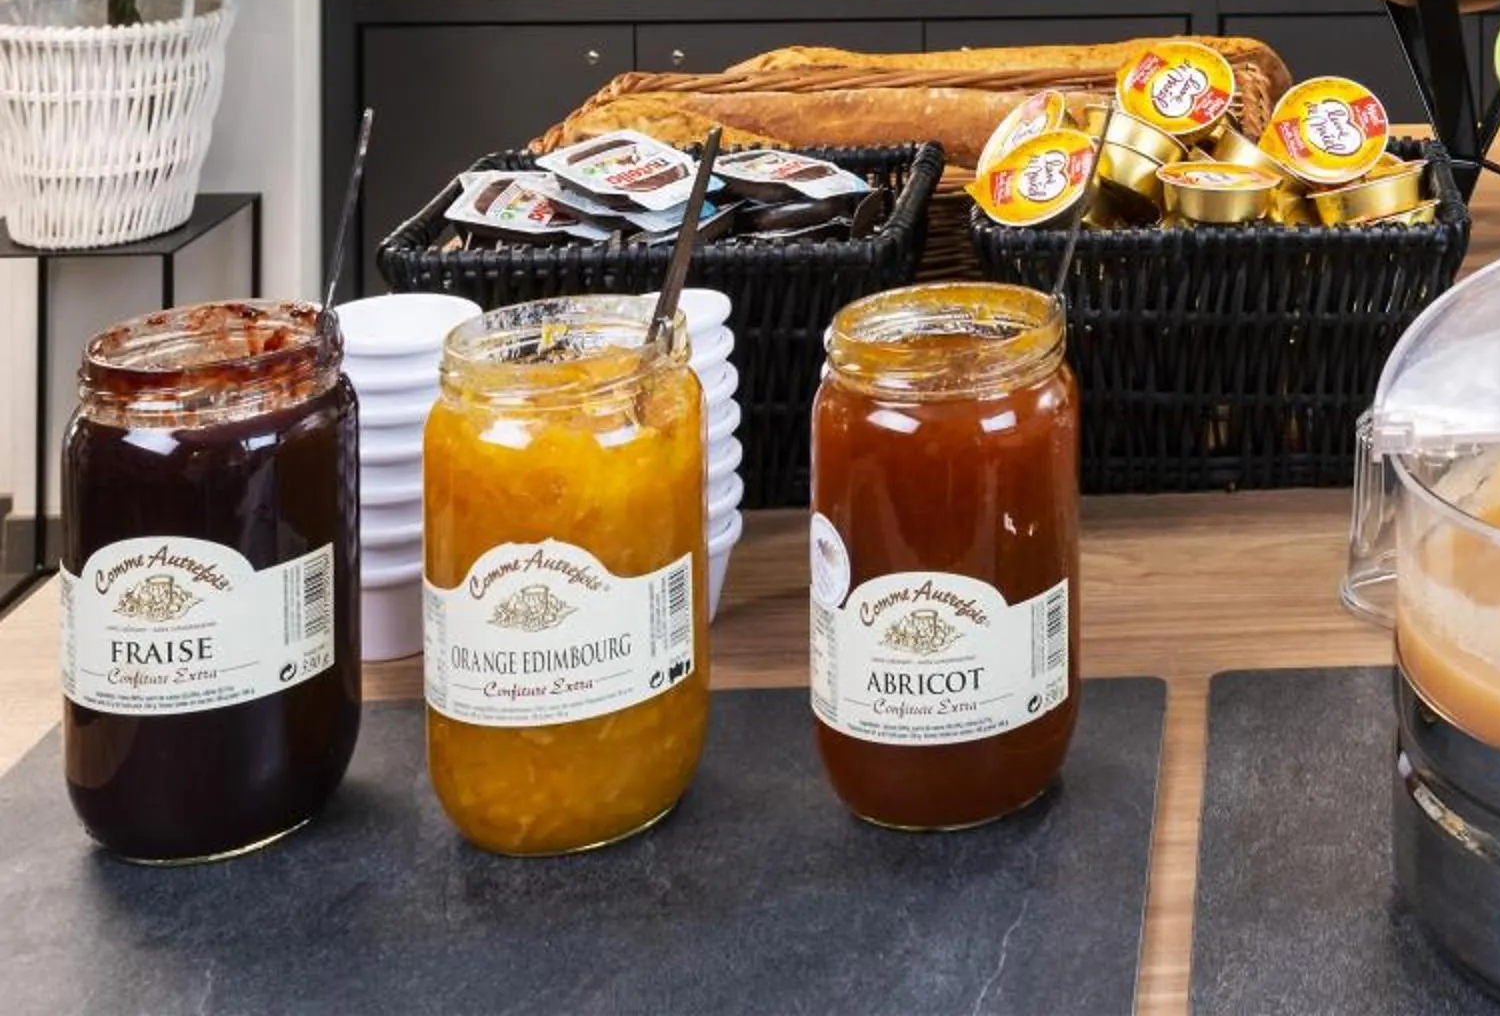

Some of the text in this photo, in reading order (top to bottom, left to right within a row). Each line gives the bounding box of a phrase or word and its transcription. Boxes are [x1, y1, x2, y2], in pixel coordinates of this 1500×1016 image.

[94, 544, 230, 595] Comme Autrefois
[469, 548, 603, 600] Comme Autrefois
[859, 579, 988, 626] Comme Autrefois
[110, 636, 214, 665] FRAISE
[451, 633, 632, 675] ORANGE EDIMBOURG
[107, 666, 218, 689] Confiture Extra
[483, 677, 594, 701] Confiture Extra
[867, 667, 985, 695] ABRICOT
[873, 698, 978, 719] Confiture Extra
